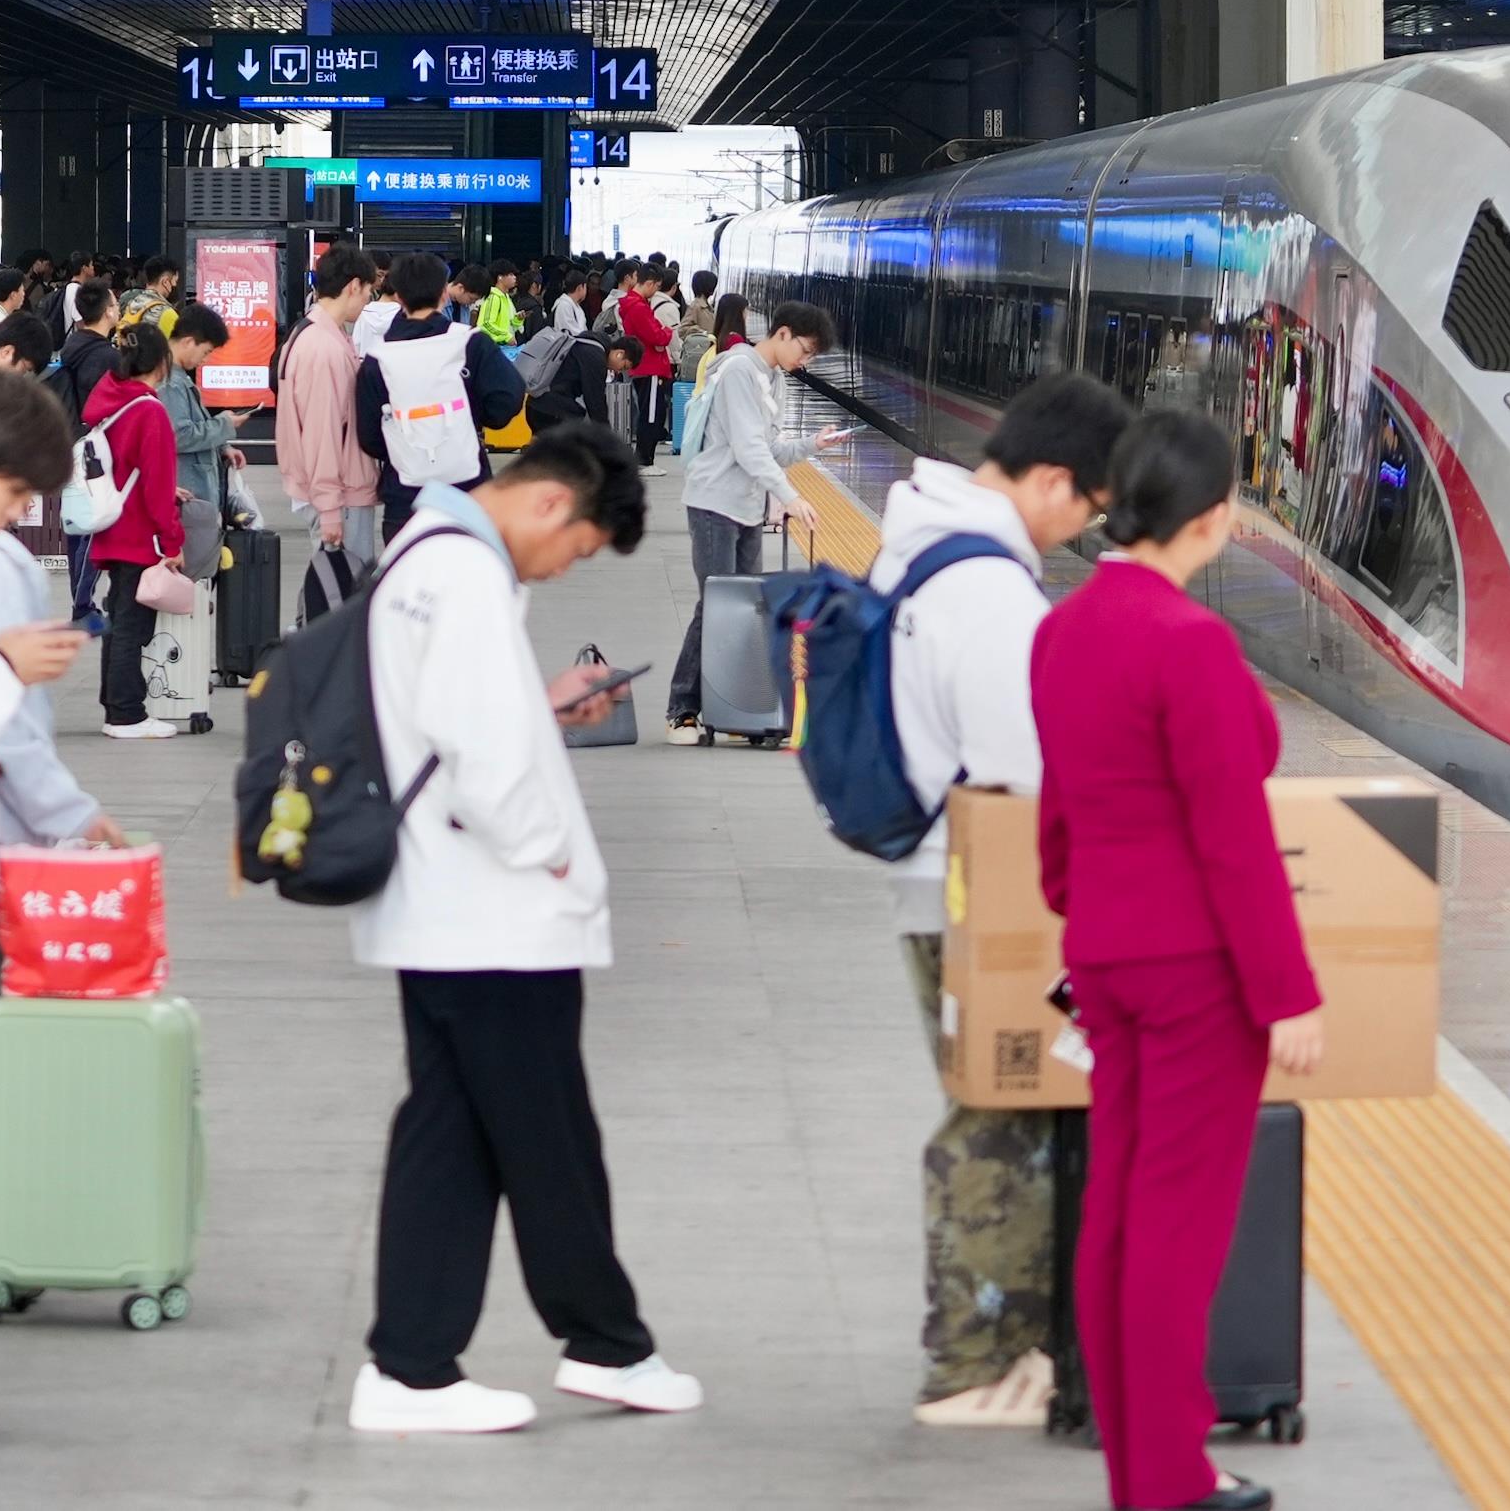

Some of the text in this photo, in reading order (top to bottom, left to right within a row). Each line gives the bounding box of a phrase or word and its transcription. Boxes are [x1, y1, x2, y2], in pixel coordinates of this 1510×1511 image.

[315, 47, 378, 70] 出站口
[491, 48, 579, 71] 便捷换乘
[315, 72, 337, 83] Exit
[491, 72, 538, 84] Transfer
[599, 57, 652, 100] 14
[596, 136, 627, 162] 14
[384, 172, 531, 190] 便捷换乘前行180米
[204, 281, 269, 298] 头部品牌
